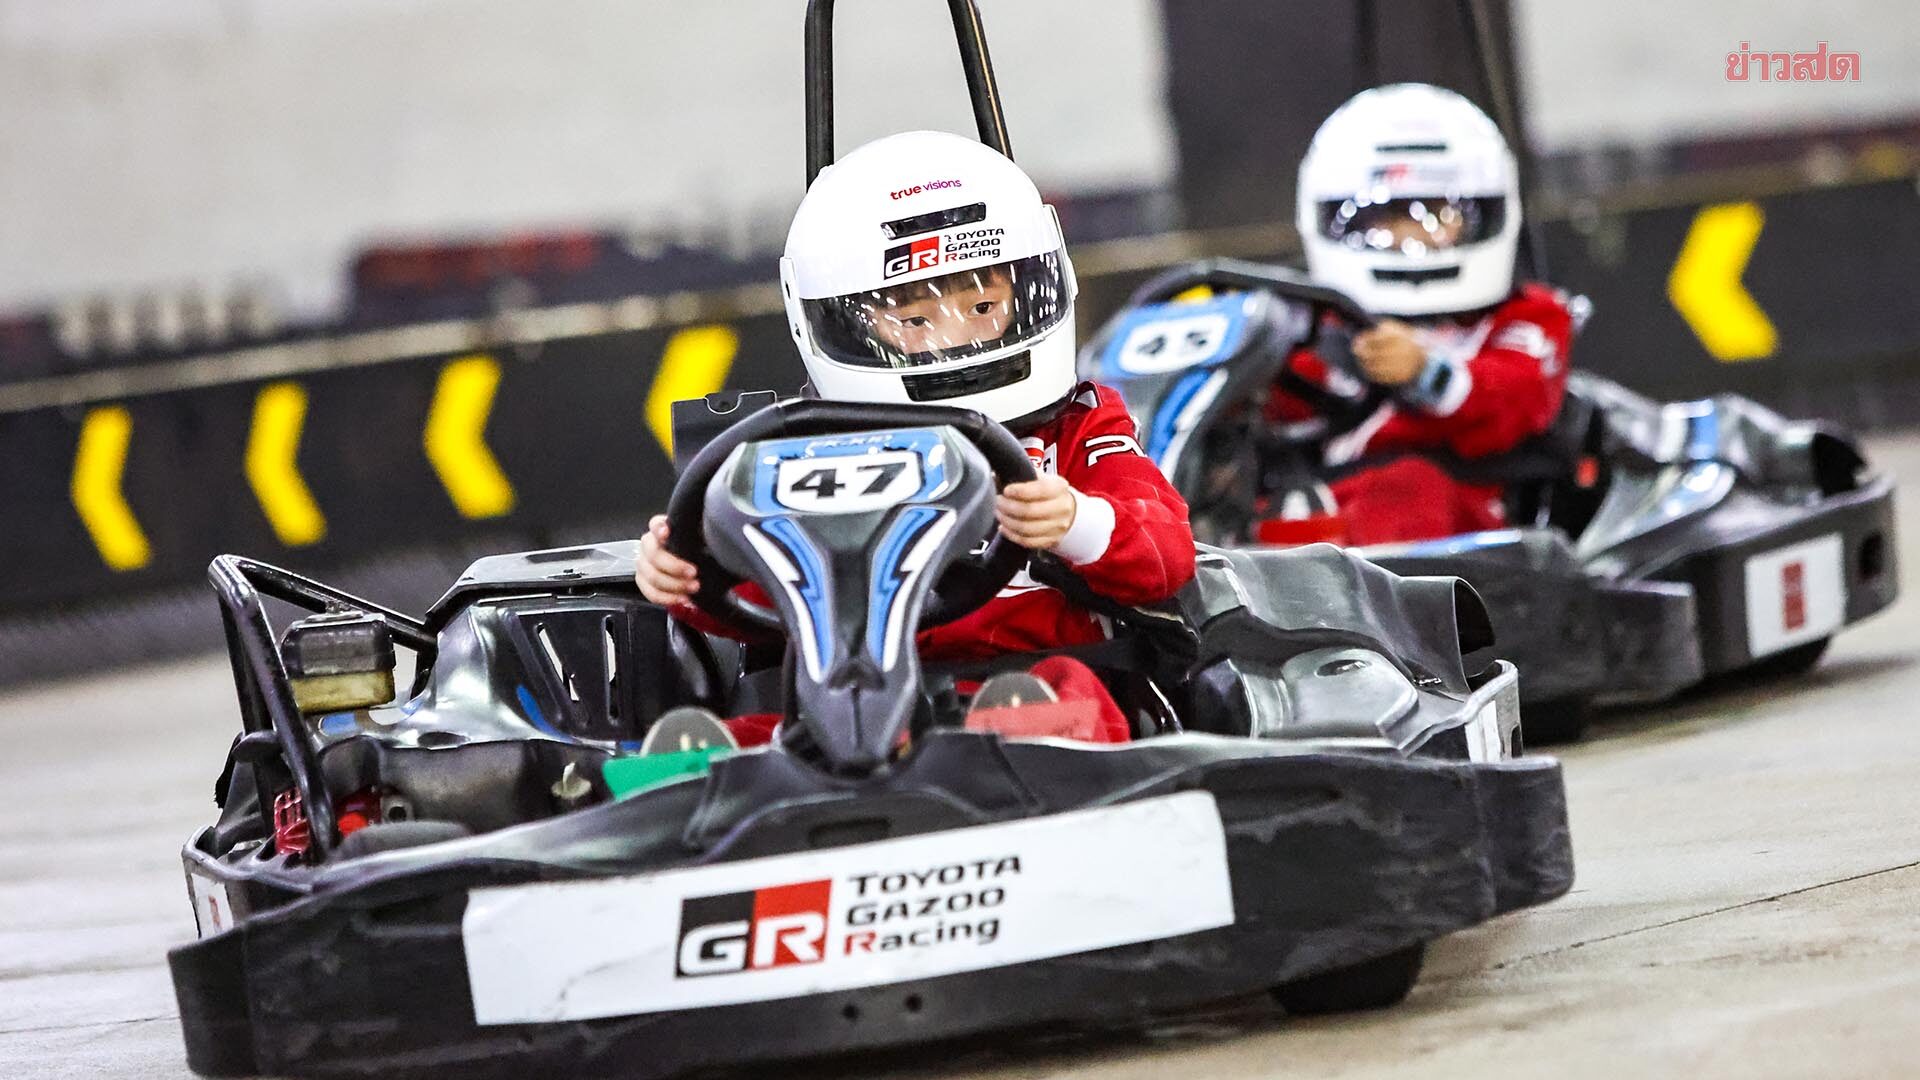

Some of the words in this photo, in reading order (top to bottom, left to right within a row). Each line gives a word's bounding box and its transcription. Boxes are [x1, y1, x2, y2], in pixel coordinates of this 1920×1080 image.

[890, 186, 921, 200] true
[923, 180, 962, 191] visions
[884, 248, 939, 278] GR
[945, 238, 1001, 253] GAZOO
[945, 249, 1001, 263] Racing
[791, 462, 907, 499] 47
[848, 855, 1022, 898] TOYOTA
[846, 888, 1006, 926] GAZOO
[678, 911, 829, 977] GR
[844, 918, 1000, 955] Racing
